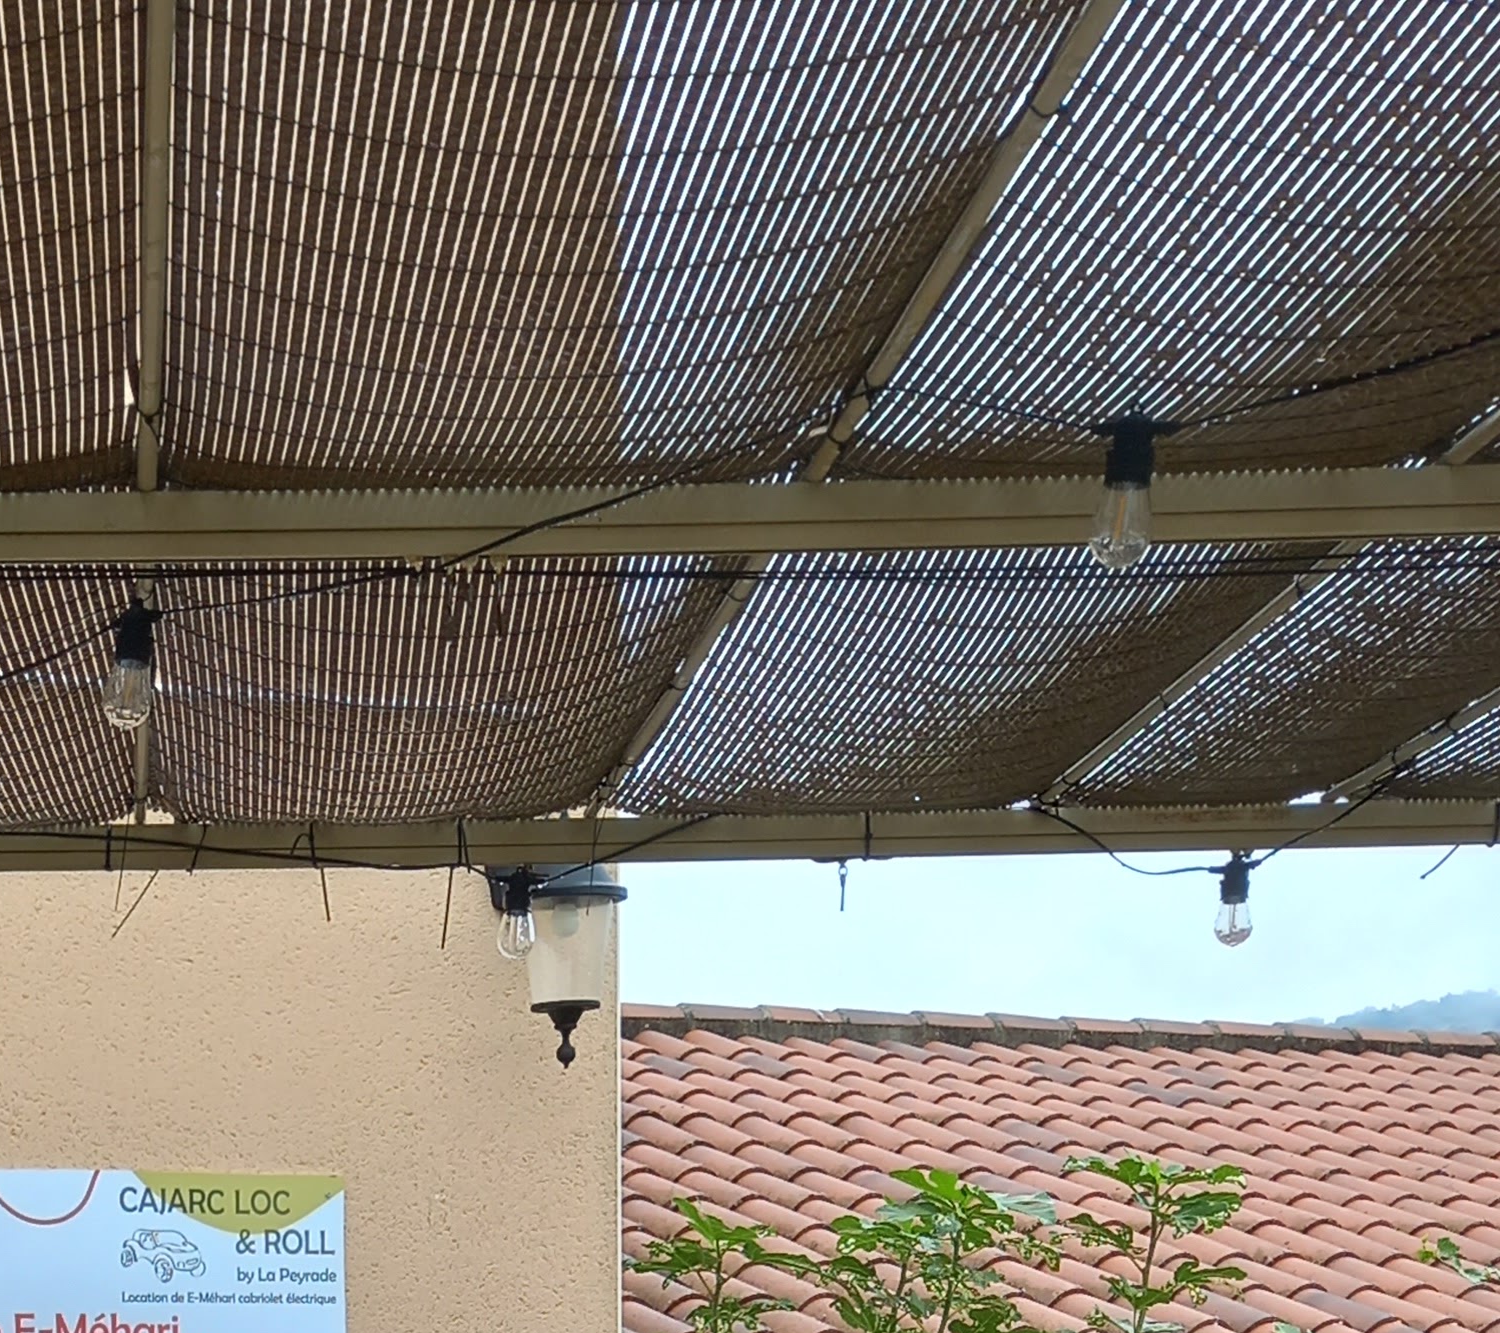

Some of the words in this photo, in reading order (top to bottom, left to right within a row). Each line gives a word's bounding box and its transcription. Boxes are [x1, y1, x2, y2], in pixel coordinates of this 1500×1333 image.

[119, 1186, 224, 1215] CAJARC
[235, 1189, 290, 1216] LOC
[235, 1229, 256, 1254] &
[264, 1229, 336, 1255] ROLL
[237, 1267, 255, 1284] by
[258, 1267, 276, 1282] La
[279, 1268, 337, 1285] Peyrade
[122, 1291, 168, 1303] Location
[171, 1292, 185, 1303] de
[187, 1292, 236, 1303] E-Méhari
[238, 1292, 284, 1304] cabriolet
[286, 1293, 337, 1306] électrique
